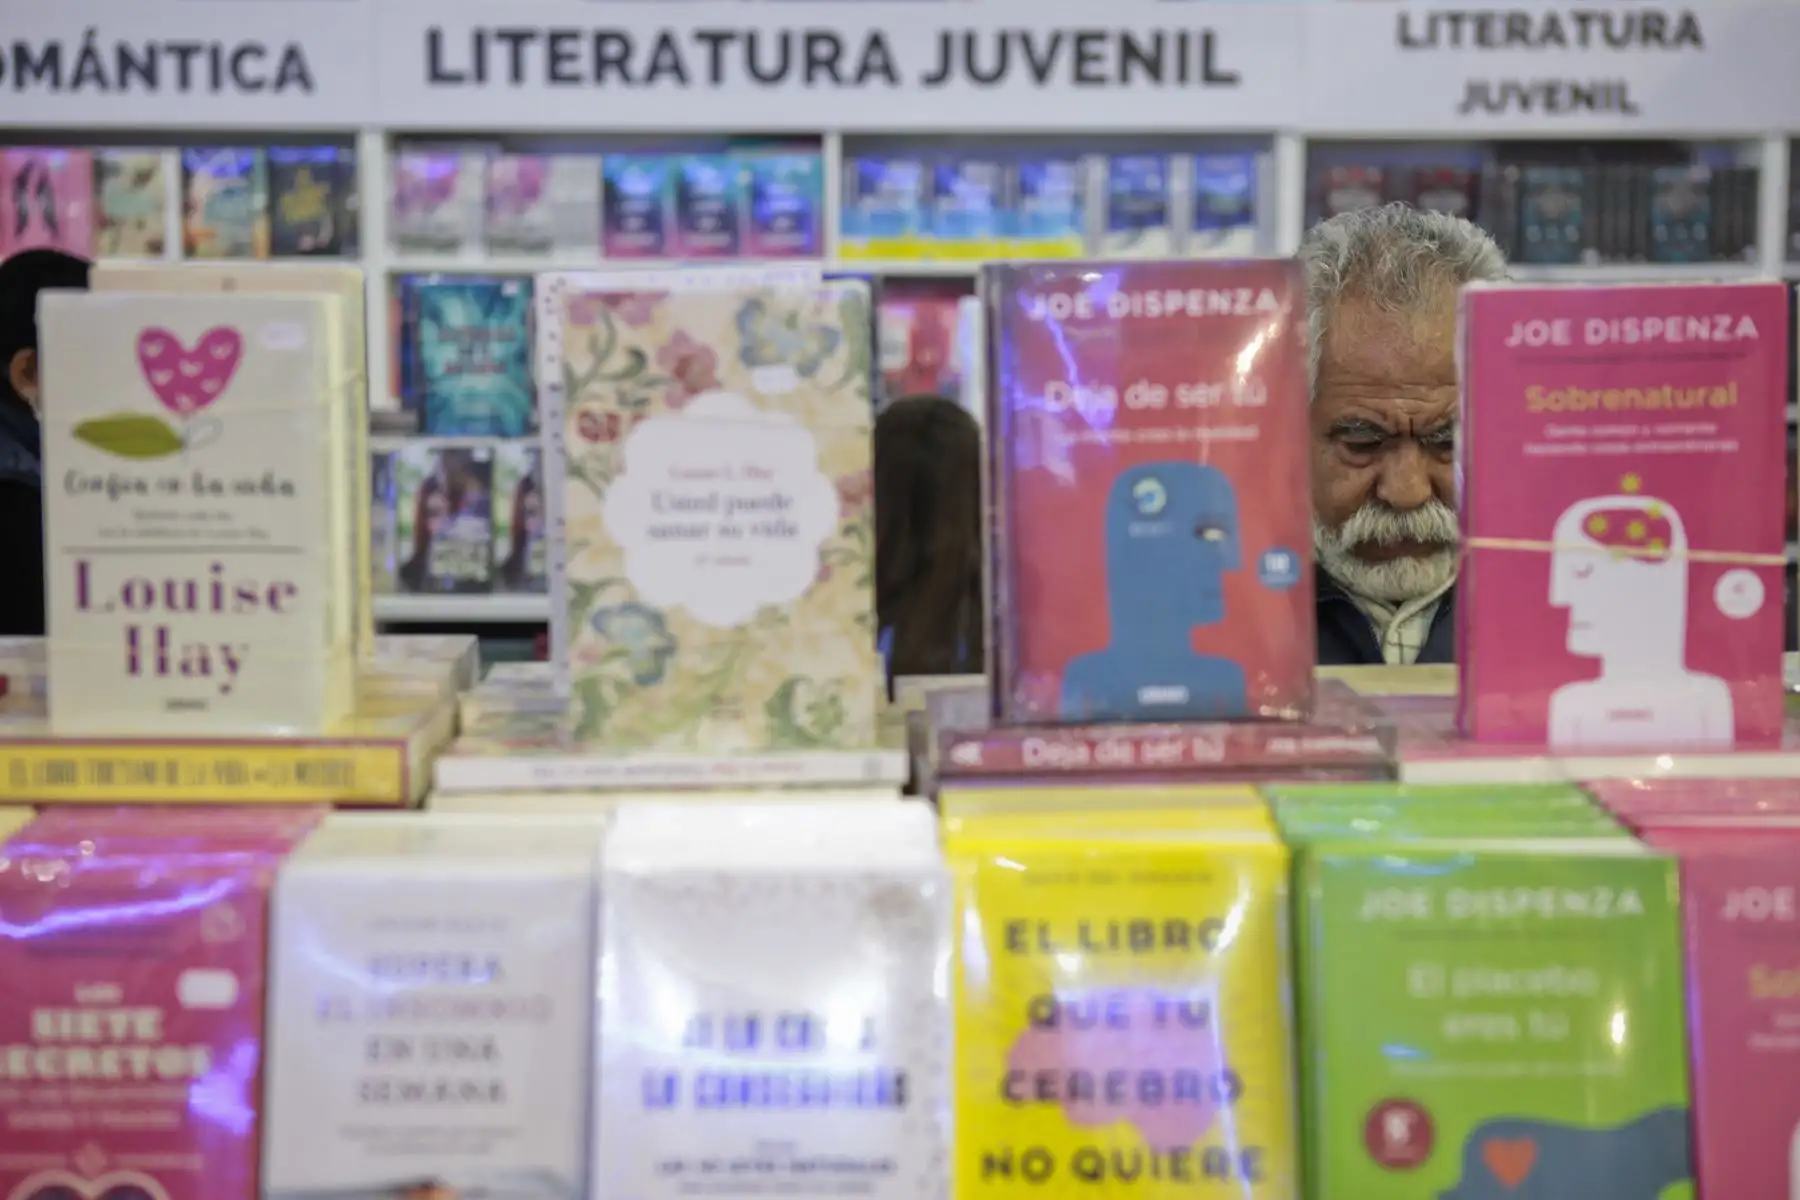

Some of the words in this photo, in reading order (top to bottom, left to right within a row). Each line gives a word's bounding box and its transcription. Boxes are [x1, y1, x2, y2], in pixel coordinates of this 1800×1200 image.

[1397, 10, 1704, 49] LITERATURA
[0, 30, 314, 93] MÁNTICA
[426, 27, 899, 86] LITERATURA
[921, 28, 1239, 86] JUVENIL
[1459, 80, 1640, 115] JUVENIL
[1029, 291, 1095, 320] JOE
[1108, 286, 1280, 319] DISPENZA
[1506, 319, 1572, 348] JOE
[1584, 315, 1760, 345] DISPENZA
[1124, 377, 1169, 411] de
[1175, 382, 1224, 410] ser
[1524, 381, 1739, 412] Sobrenatural
[73, 559, 298, 615] Louise
[125, 624, 249, 696] Hay
[1022, 738, 1088, 769] Deja
[1360, 887, 1430, 920] JOE
[1445, 886, 1645, 917] DISPENZA
[1719, 886, 1796, 922] JOE
[1005, 919, 1058, 952] EL
[33, 1008, 164, 1042] SIETE
[1028, 993, 1131, 1033] QUE
[0, 1046, 212, 1080] ECRETOS
[1001, 1068, 1245, 1110] CEREBRO
[979, 1145, 1057, 1185] NO
[1071, 1145, 1267, 1185] QUIERE
